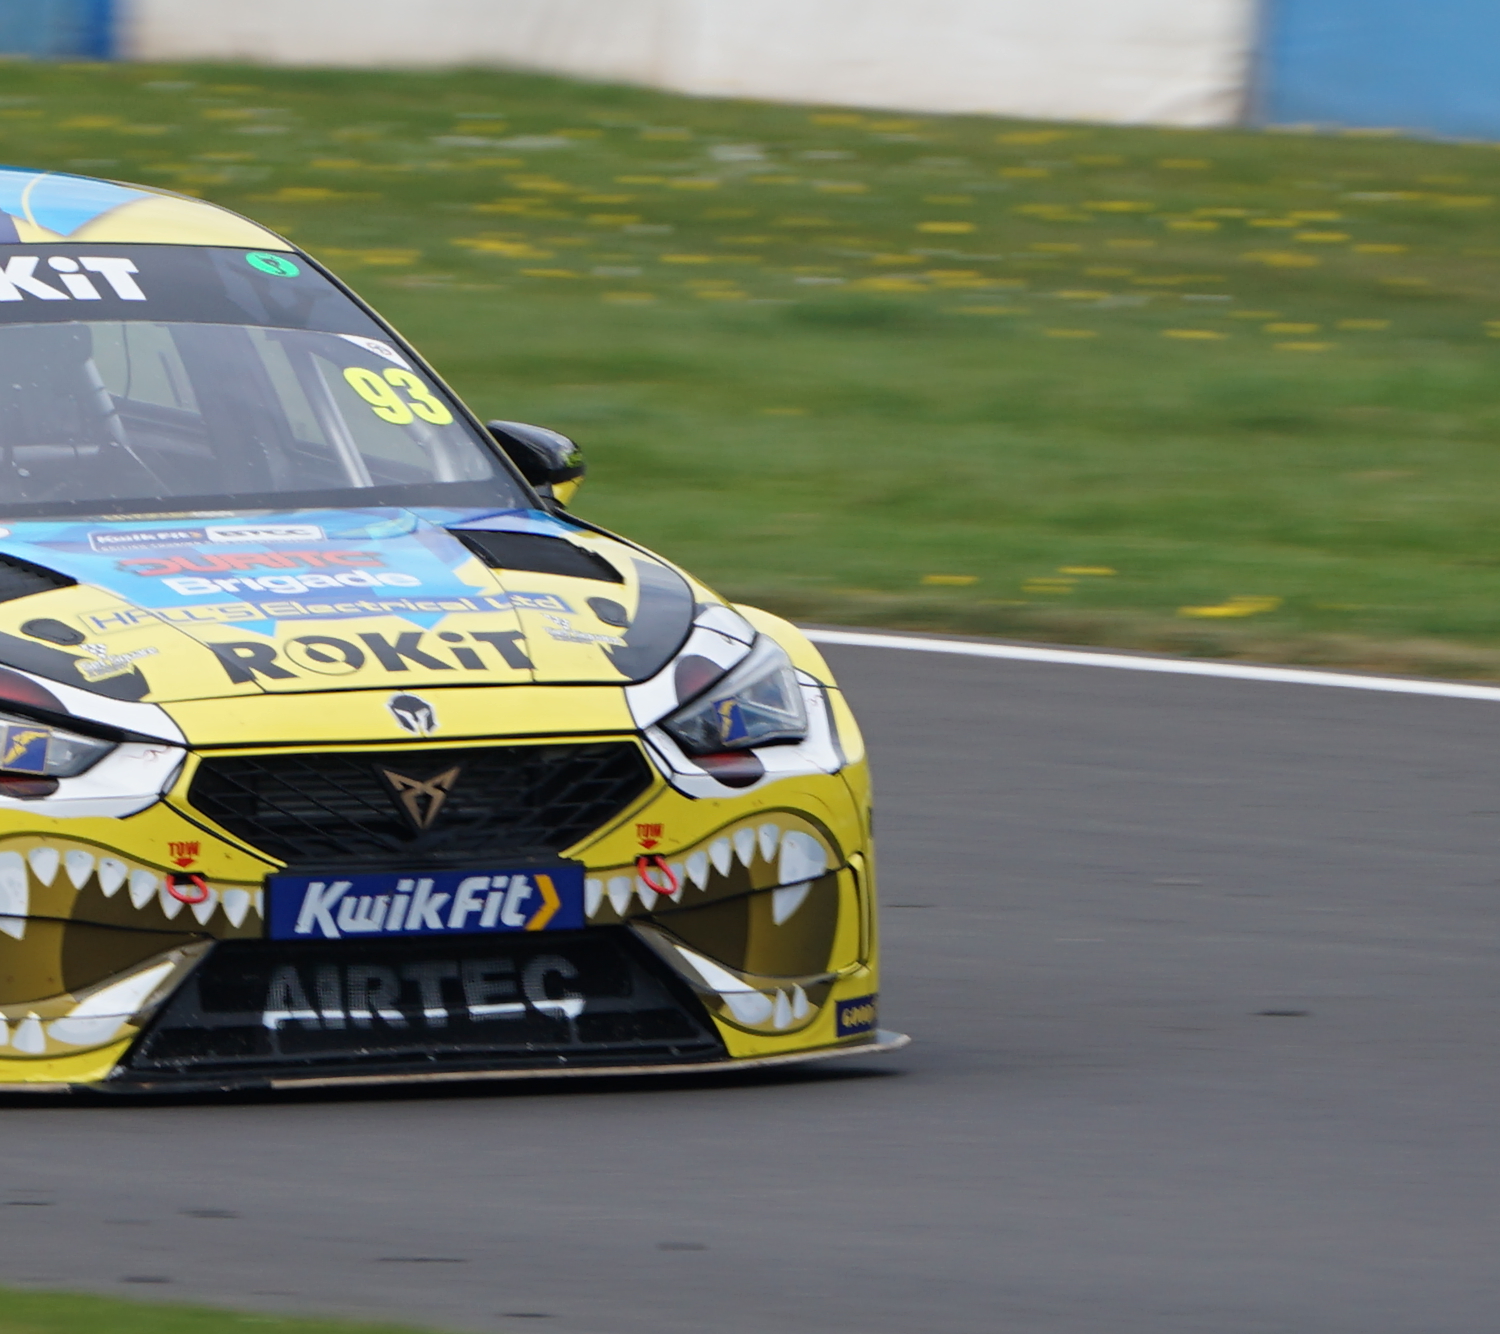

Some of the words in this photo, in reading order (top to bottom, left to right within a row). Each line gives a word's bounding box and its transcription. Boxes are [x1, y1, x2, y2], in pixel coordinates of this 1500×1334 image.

[343, 367, 454, 425] 93
[161, 569, 422, 595] Brigade
[85, 603, 261, 629] HALL'S
[260, 598, 478, 616] Electrical
[487, 593, 565, 611] Ltd
[206, 630, 536, 684] ROKiT
[635, 823, 665, 838] TOW
[167, 841, 200, 857] TOW
[262, 953, 587, 1030] AIRTEC
